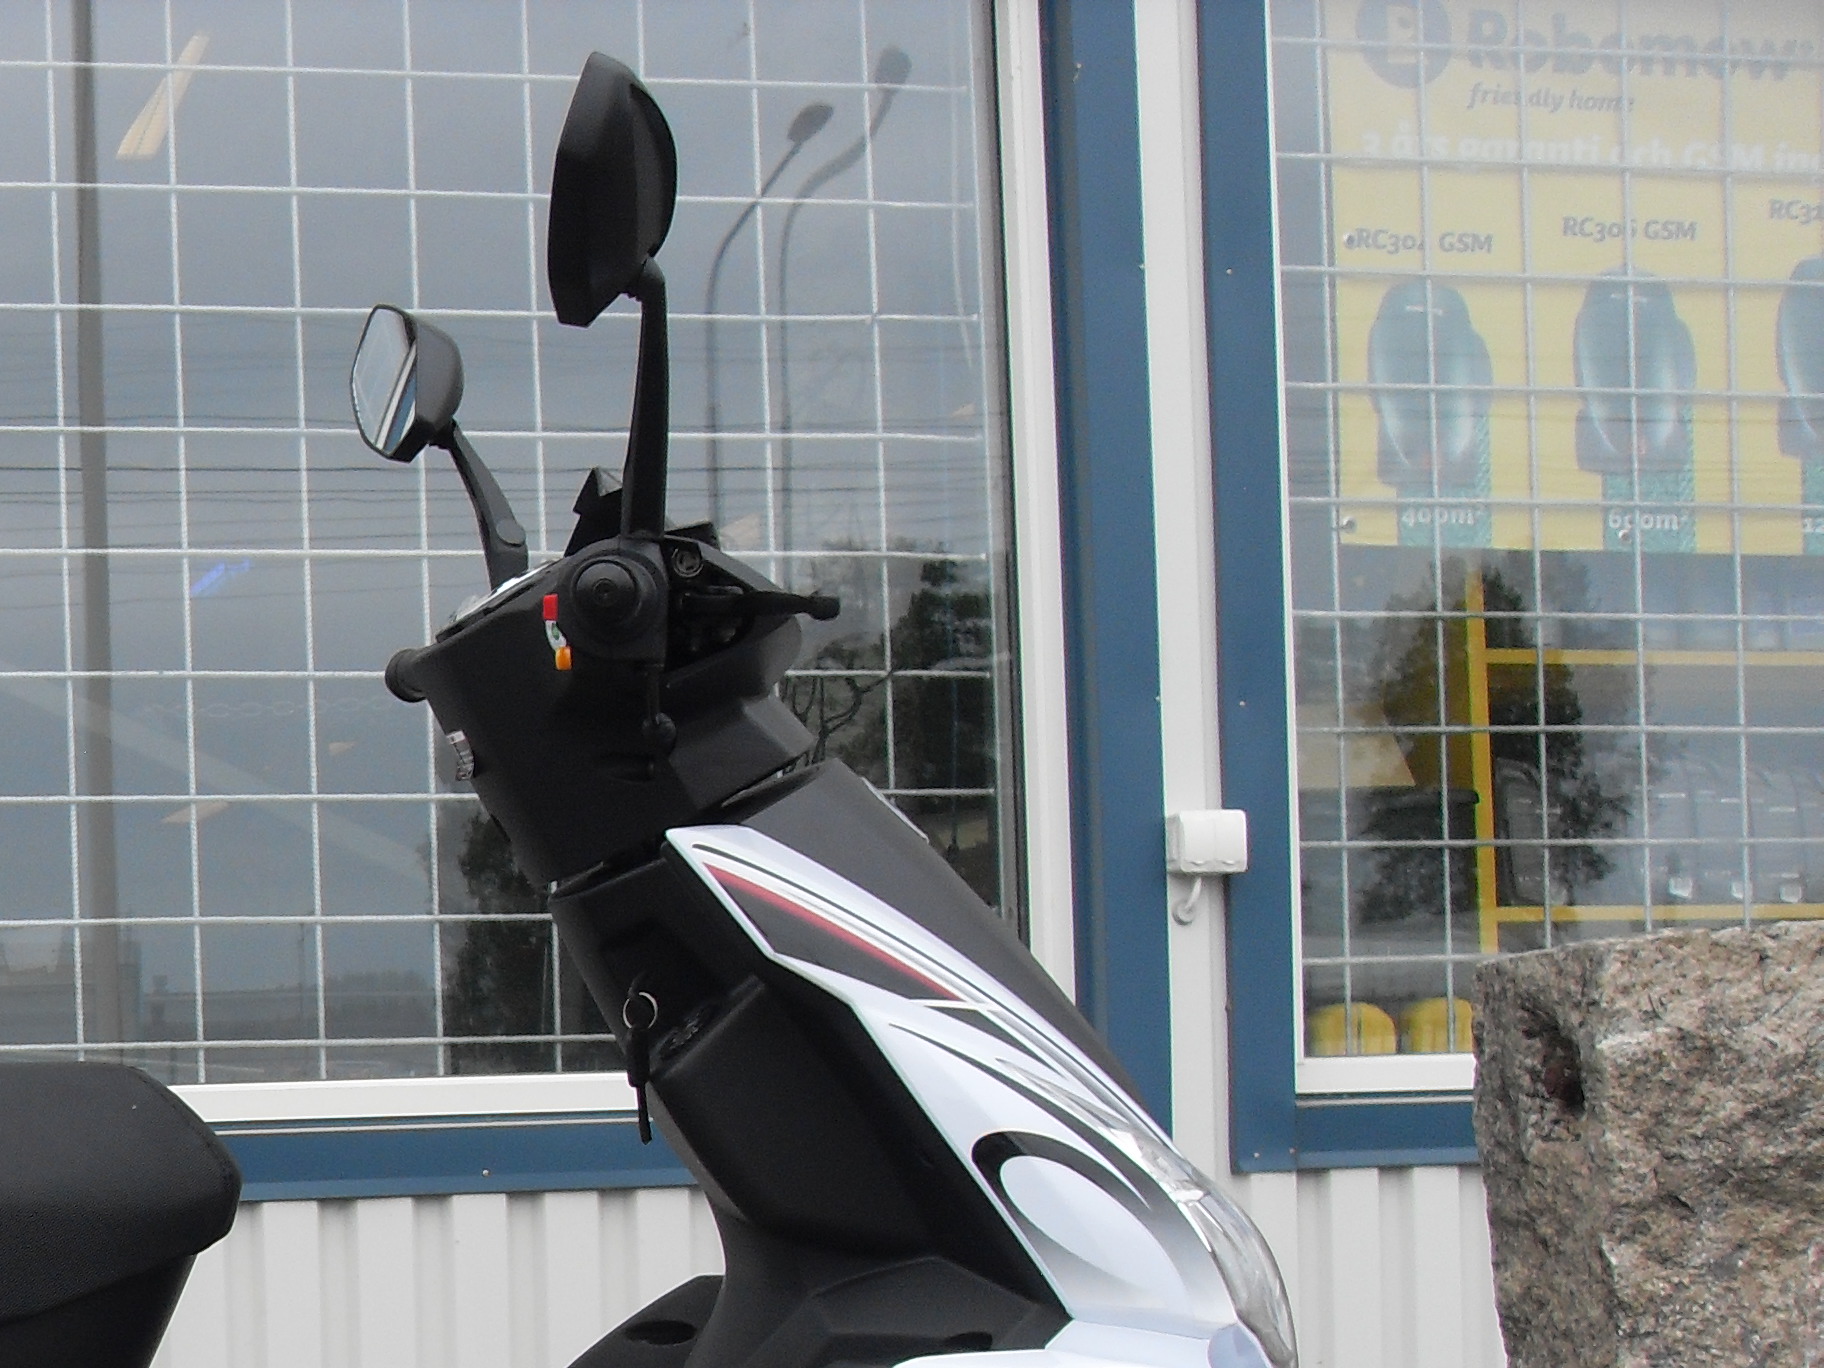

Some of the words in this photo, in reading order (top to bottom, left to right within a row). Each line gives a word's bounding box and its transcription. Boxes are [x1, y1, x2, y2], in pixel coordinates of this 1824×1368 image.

[1467, 8, 1796, 80] Robomow
[1391, 118, 1450, 161] ås
[1439, 232, 1494, 254] GSM
[1644, 219, 1698, 241] GSM
